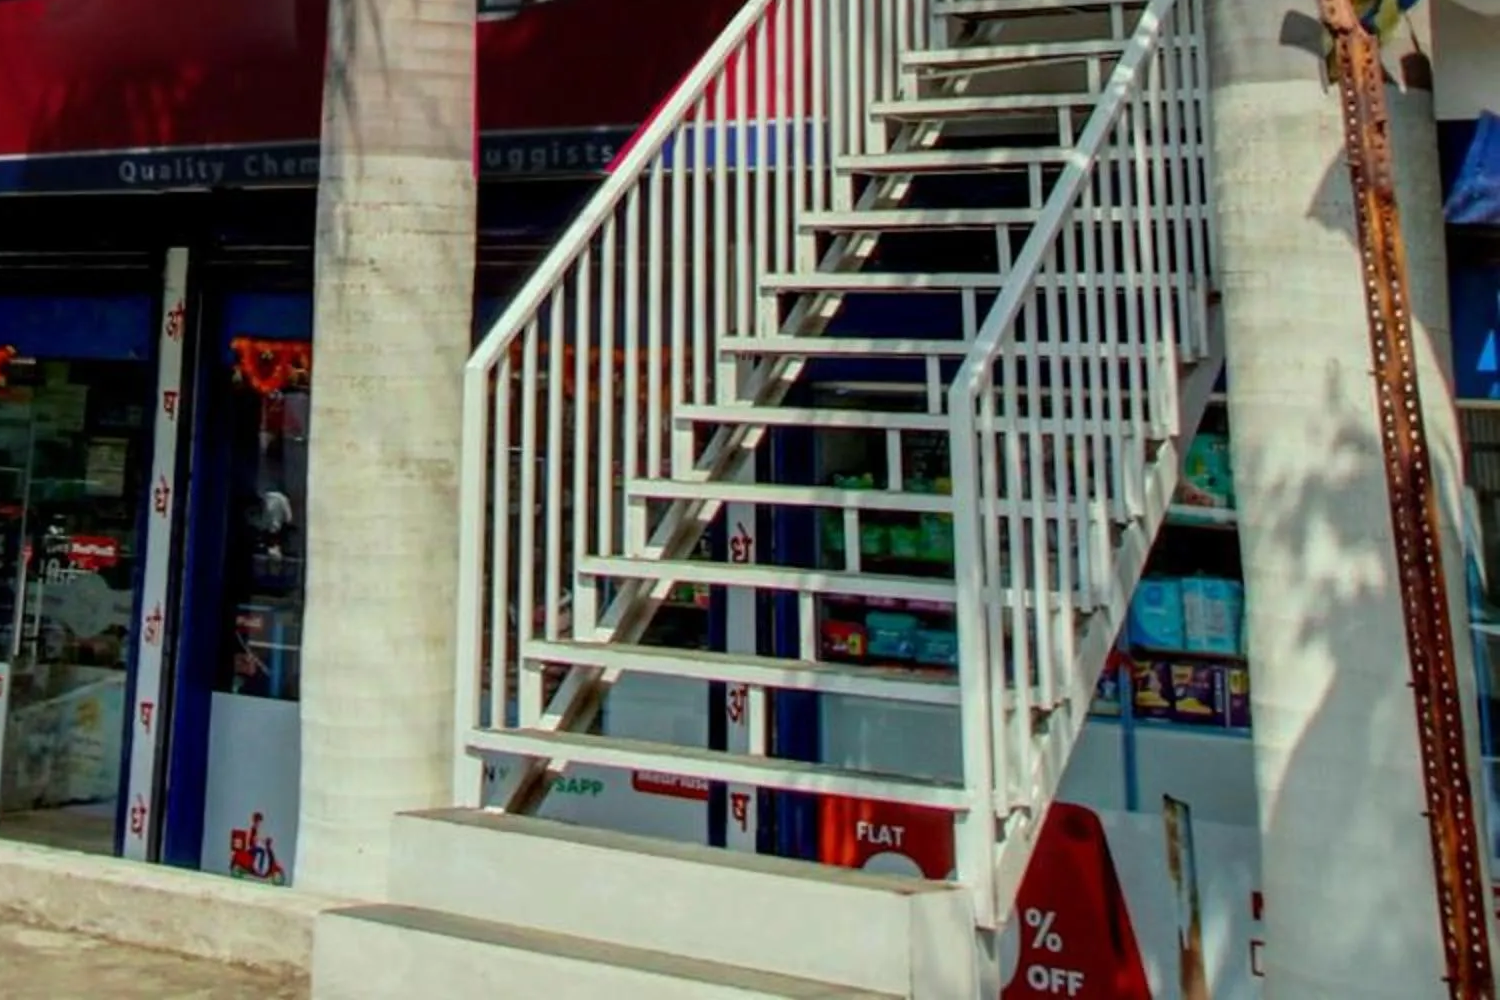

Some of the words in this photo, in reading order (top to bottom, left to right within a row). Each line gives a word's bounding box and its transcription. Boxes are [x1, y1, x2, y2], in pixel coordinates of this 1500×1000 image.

[118, 156, 225, 184] Quality
[243, 153, 320, 178] Chem
[485, 145, 615, 172] uggists
[856, 820, 905, 847] FLAT
[1025, 908, 1062, 951] %
[1027, 964, 1085, 996] OFF
